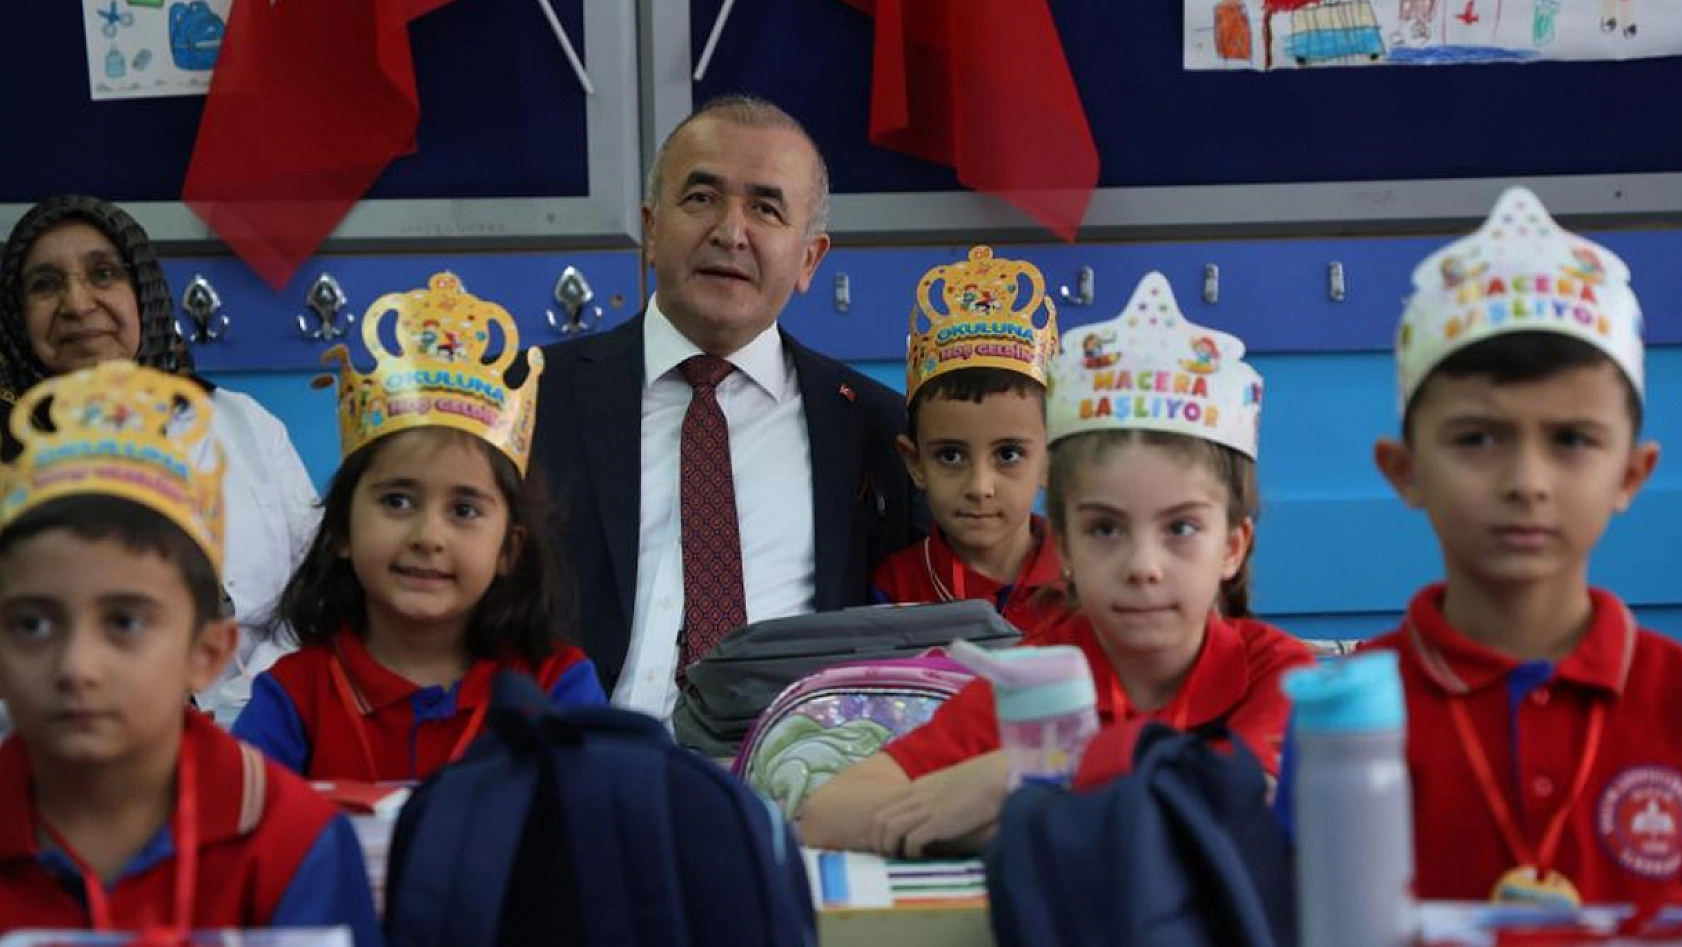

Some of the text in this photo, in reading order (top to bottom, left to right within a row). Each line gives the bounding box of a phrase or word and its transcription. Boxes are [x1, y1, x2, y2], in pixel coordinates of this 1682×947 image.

[936, 322, 1035, 341] OKULUNA
[385, 369, 504, 404] OKULUNA
[1094, 370, 1208, 397] MACERA
[1079, 396, 1219, 427] BAŞLIYOR
